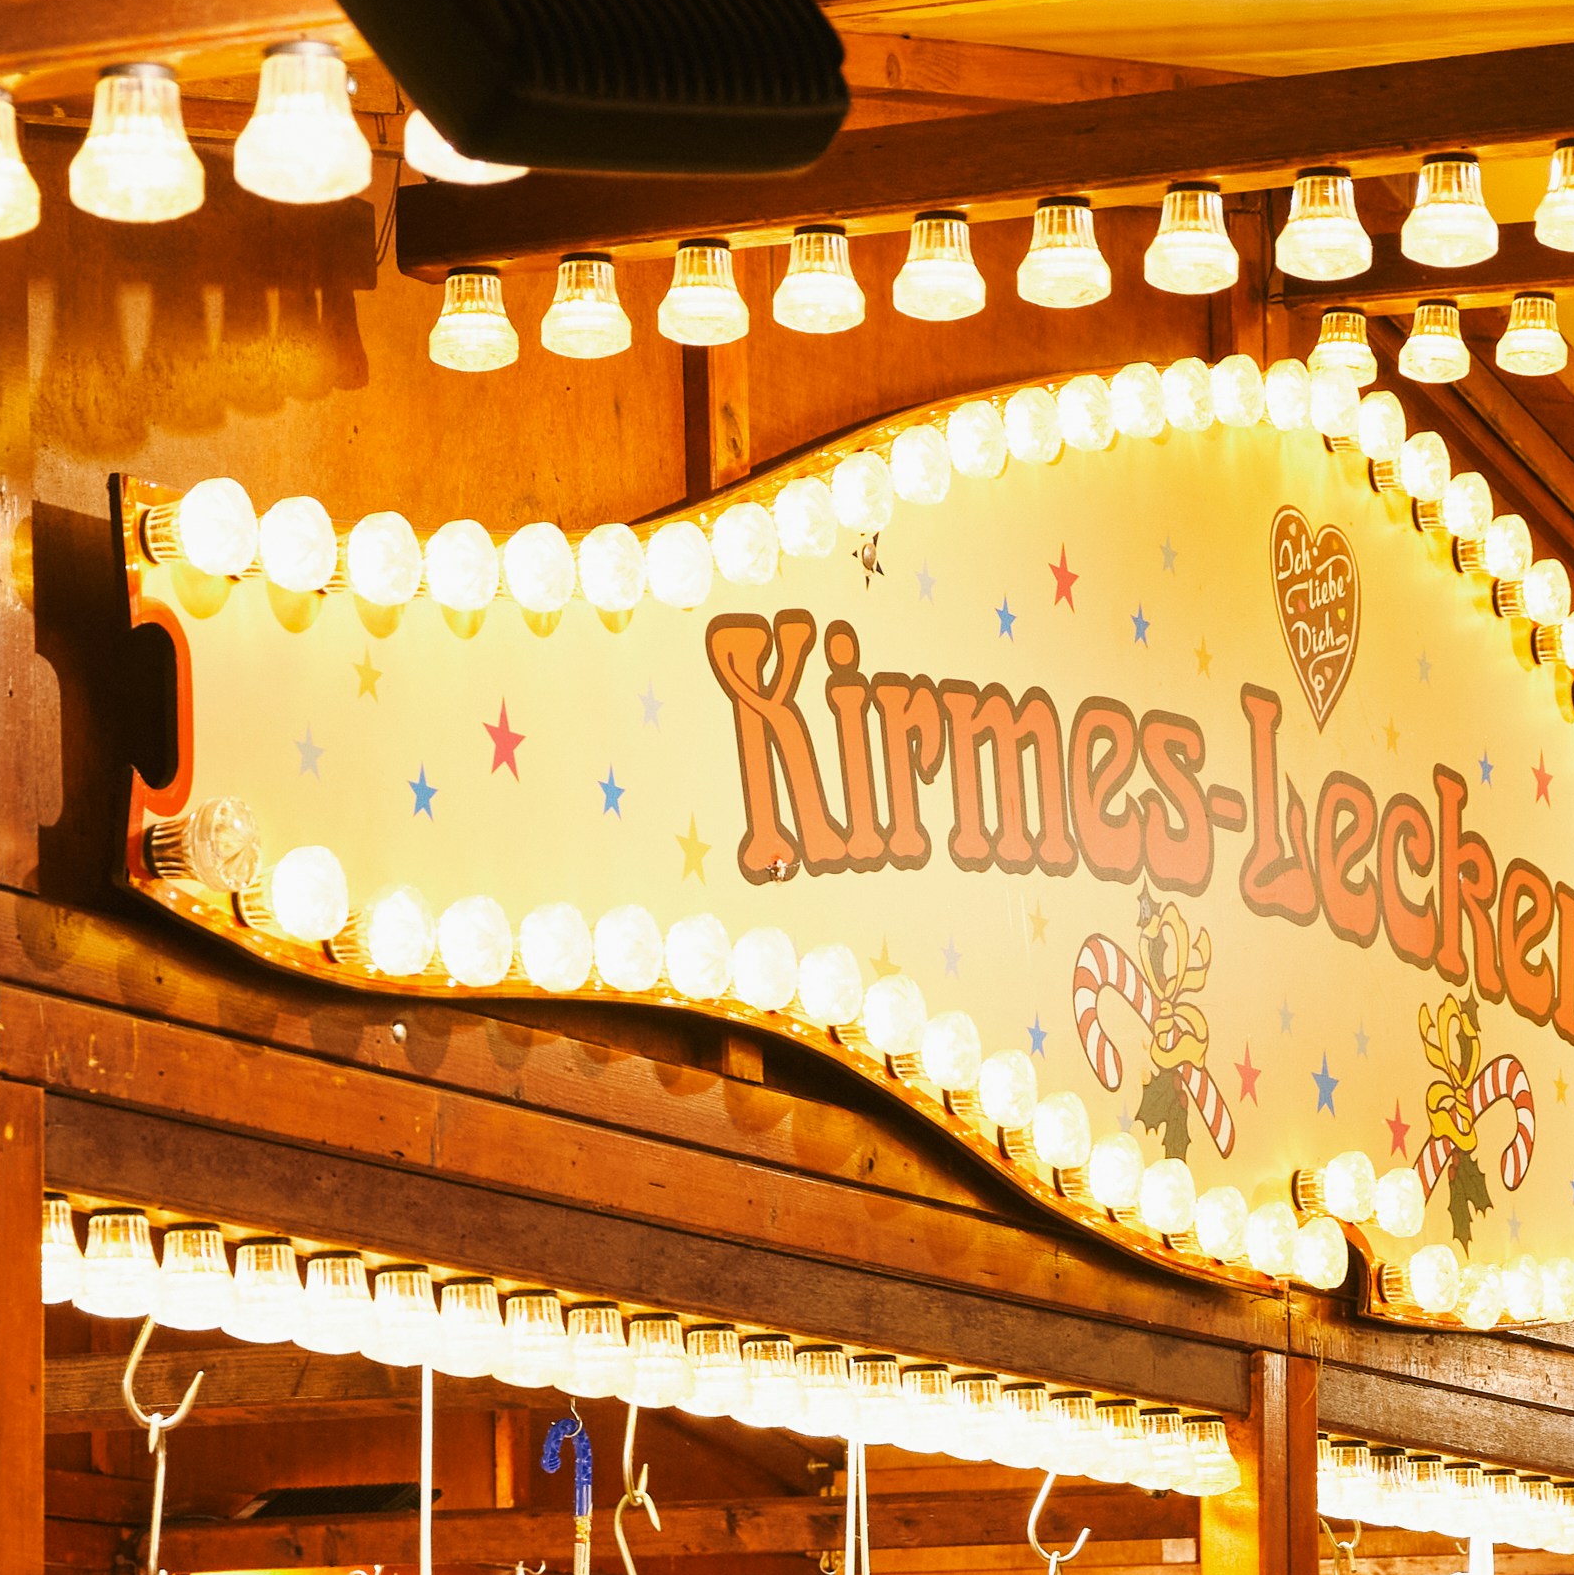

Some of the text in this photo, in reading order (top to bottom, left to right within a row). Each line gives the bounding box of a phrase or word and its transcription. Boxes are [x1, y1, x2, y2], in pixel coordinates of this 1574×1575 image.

[1277, 534, 1312, 581] Ich
[1307, 565, 1346, 610] liebe
[1291, 611, 1337, 660] Dich
